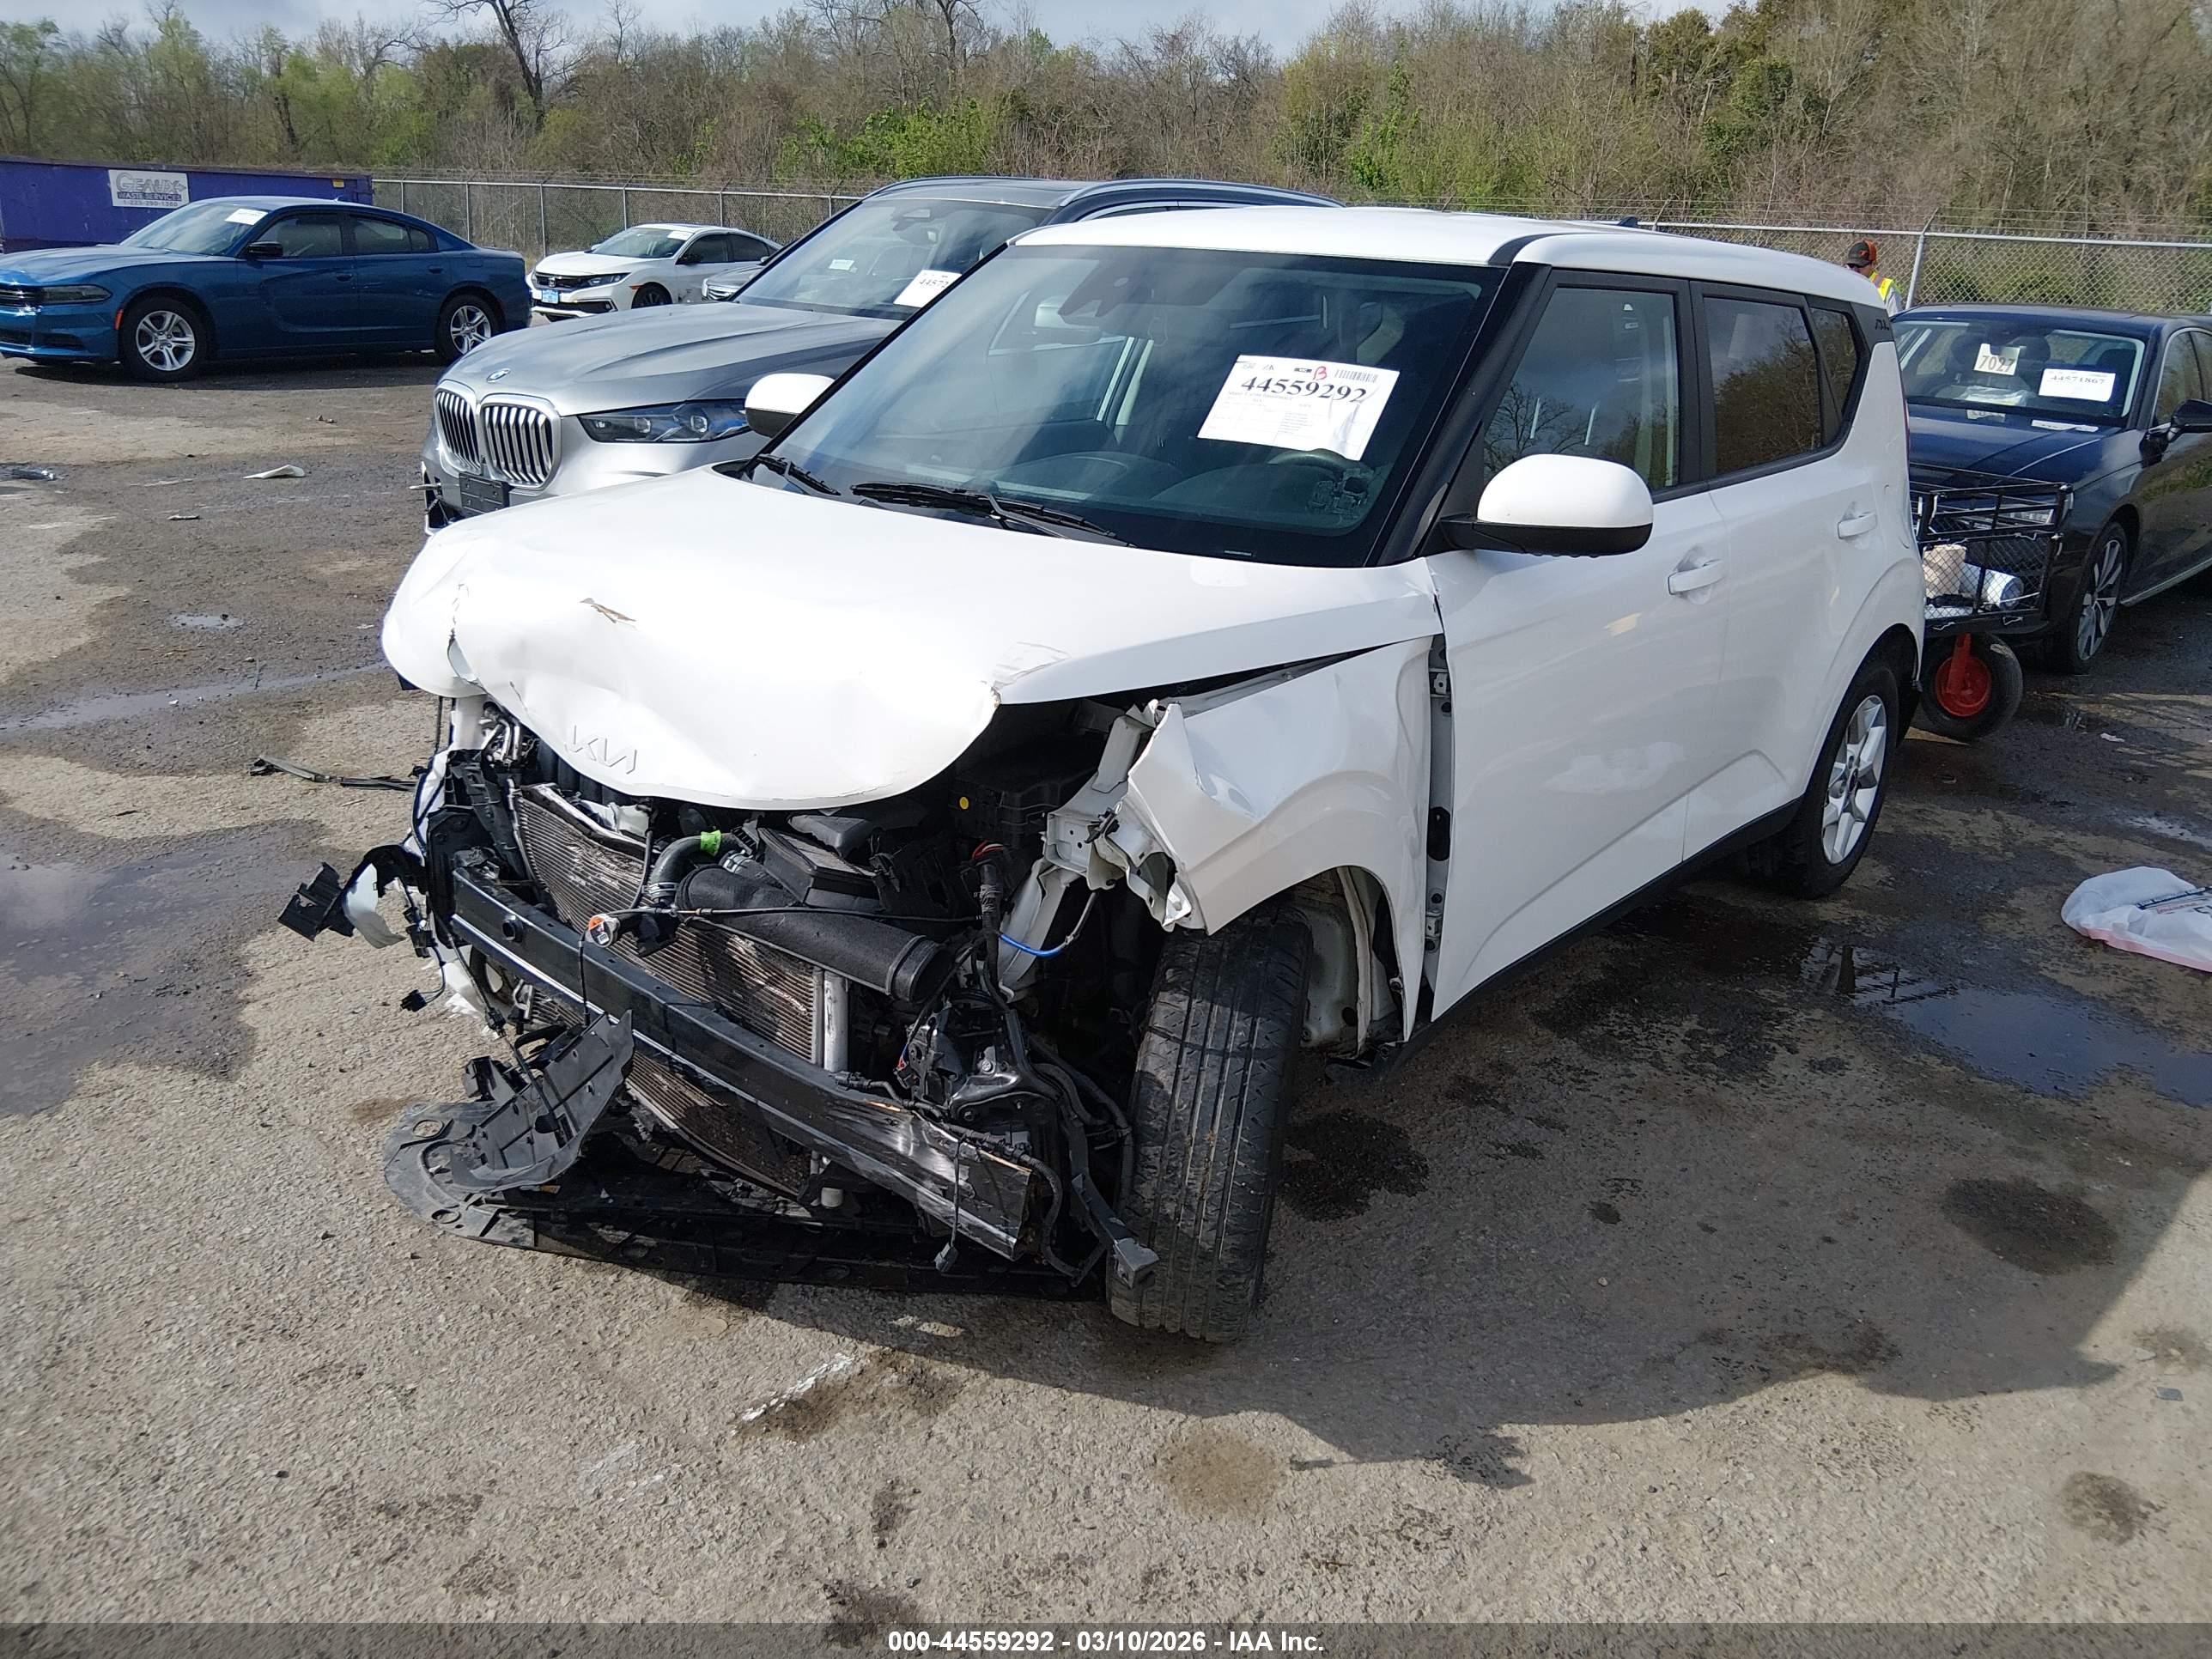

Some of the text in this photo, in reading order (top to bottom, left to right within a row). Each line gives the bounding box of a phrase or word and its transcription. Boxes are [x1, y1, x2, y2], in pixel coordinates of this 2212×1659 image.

[117, 173, 181, 193] GEAUX
[1978, 355, 2016, 373] 7027
[1241, 376, 1367, 404] 44559292
